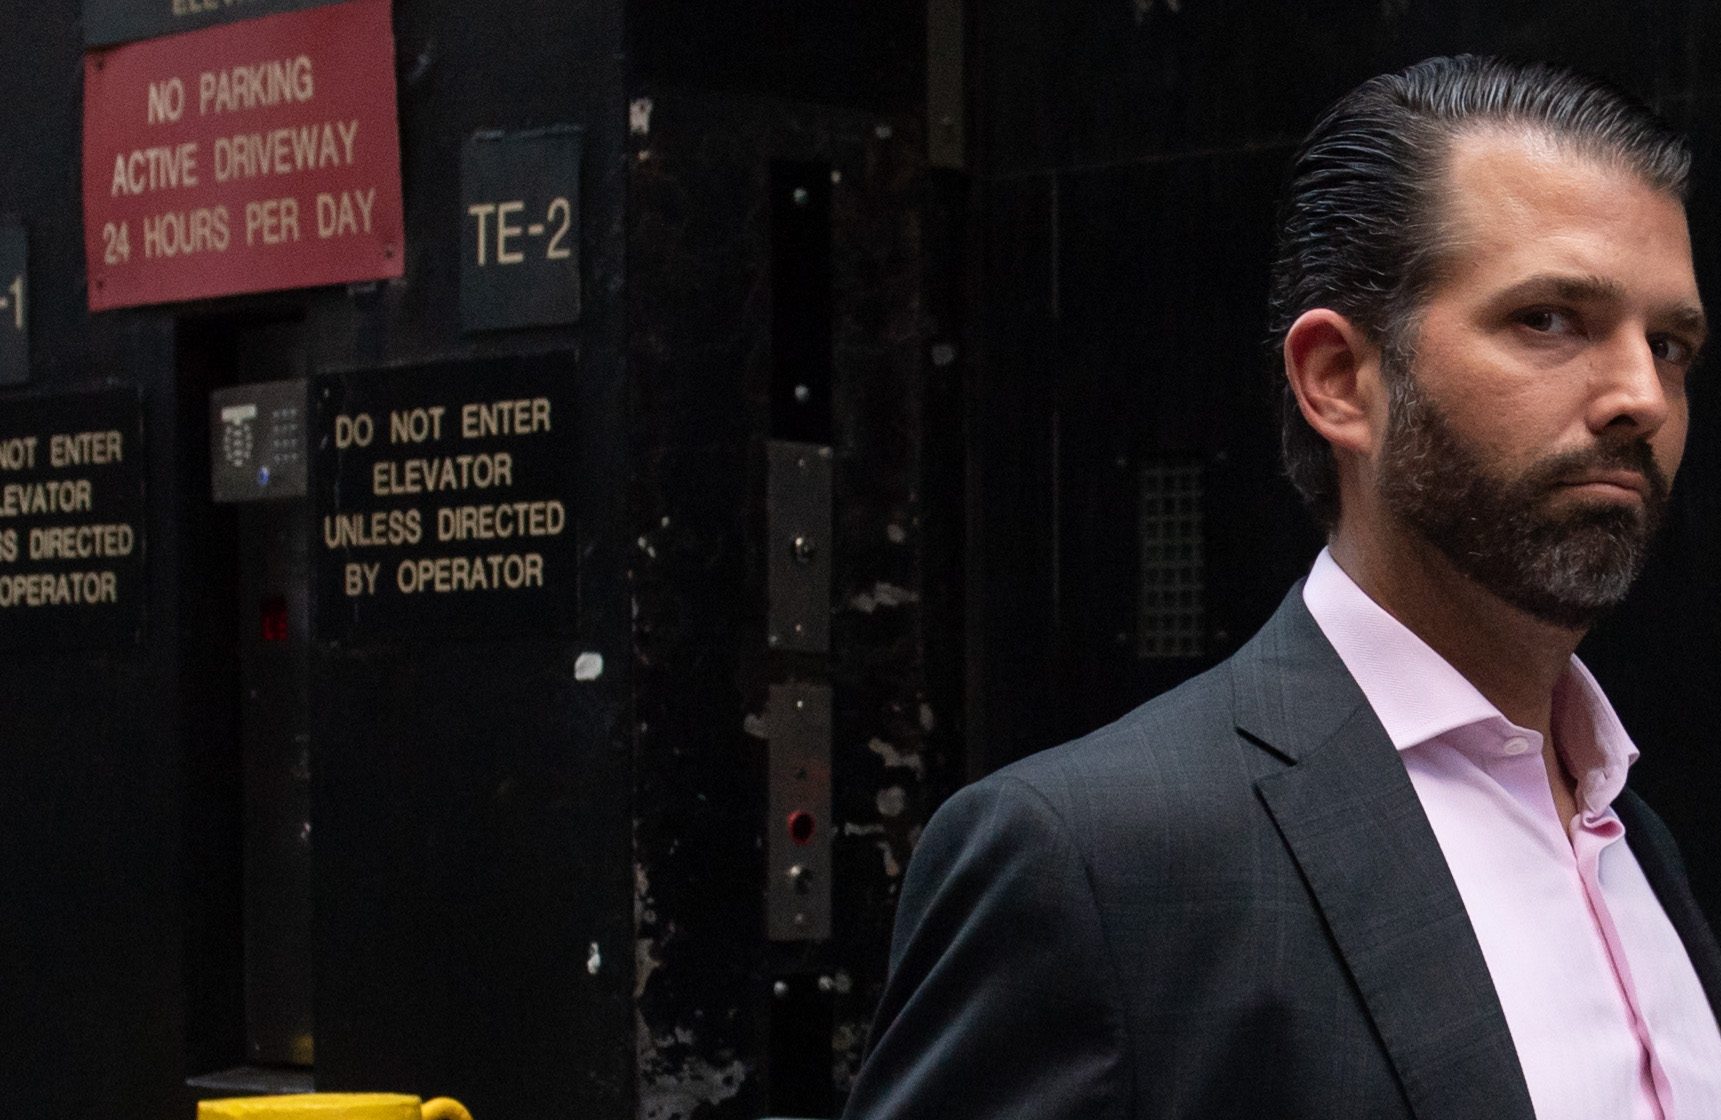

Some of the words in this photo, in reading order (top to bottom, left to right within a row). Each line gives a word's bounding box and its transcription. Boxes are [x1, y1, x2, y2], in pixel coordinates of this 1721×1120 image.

[148, 76, 186, 124] NO
[200, 55, 315, 116] PARKING
[111, 142, 199, 197] ACTIVE
[214, 119, 359, 182] DRIVEWAY
[103, 218, 131, 265] 24
[144, 204, 230, 258] HOURS
[246, 197, 300, 246] PER
[316, 188, 376, 239] DAY
[468, 197, 571, 267] TE-2
[335, 413, 374, 449] DO
[390, 406, 446, 445] NOT
[461, 397, 551, 439] ENTER
[50, 431, 123, 467] ENTER
[372, 452, 513, 496] ELEVATOR
[29, 523, 135, 560] DIRECTED
[324, 508, 422, 549] UNLESS
[437, 500, 566, 542] DIRECTED
[0, 570, 118, 607] OPERATOR
[345, 562, 380, 596] BY
[397, 552, 544, 594] OPERATOR
